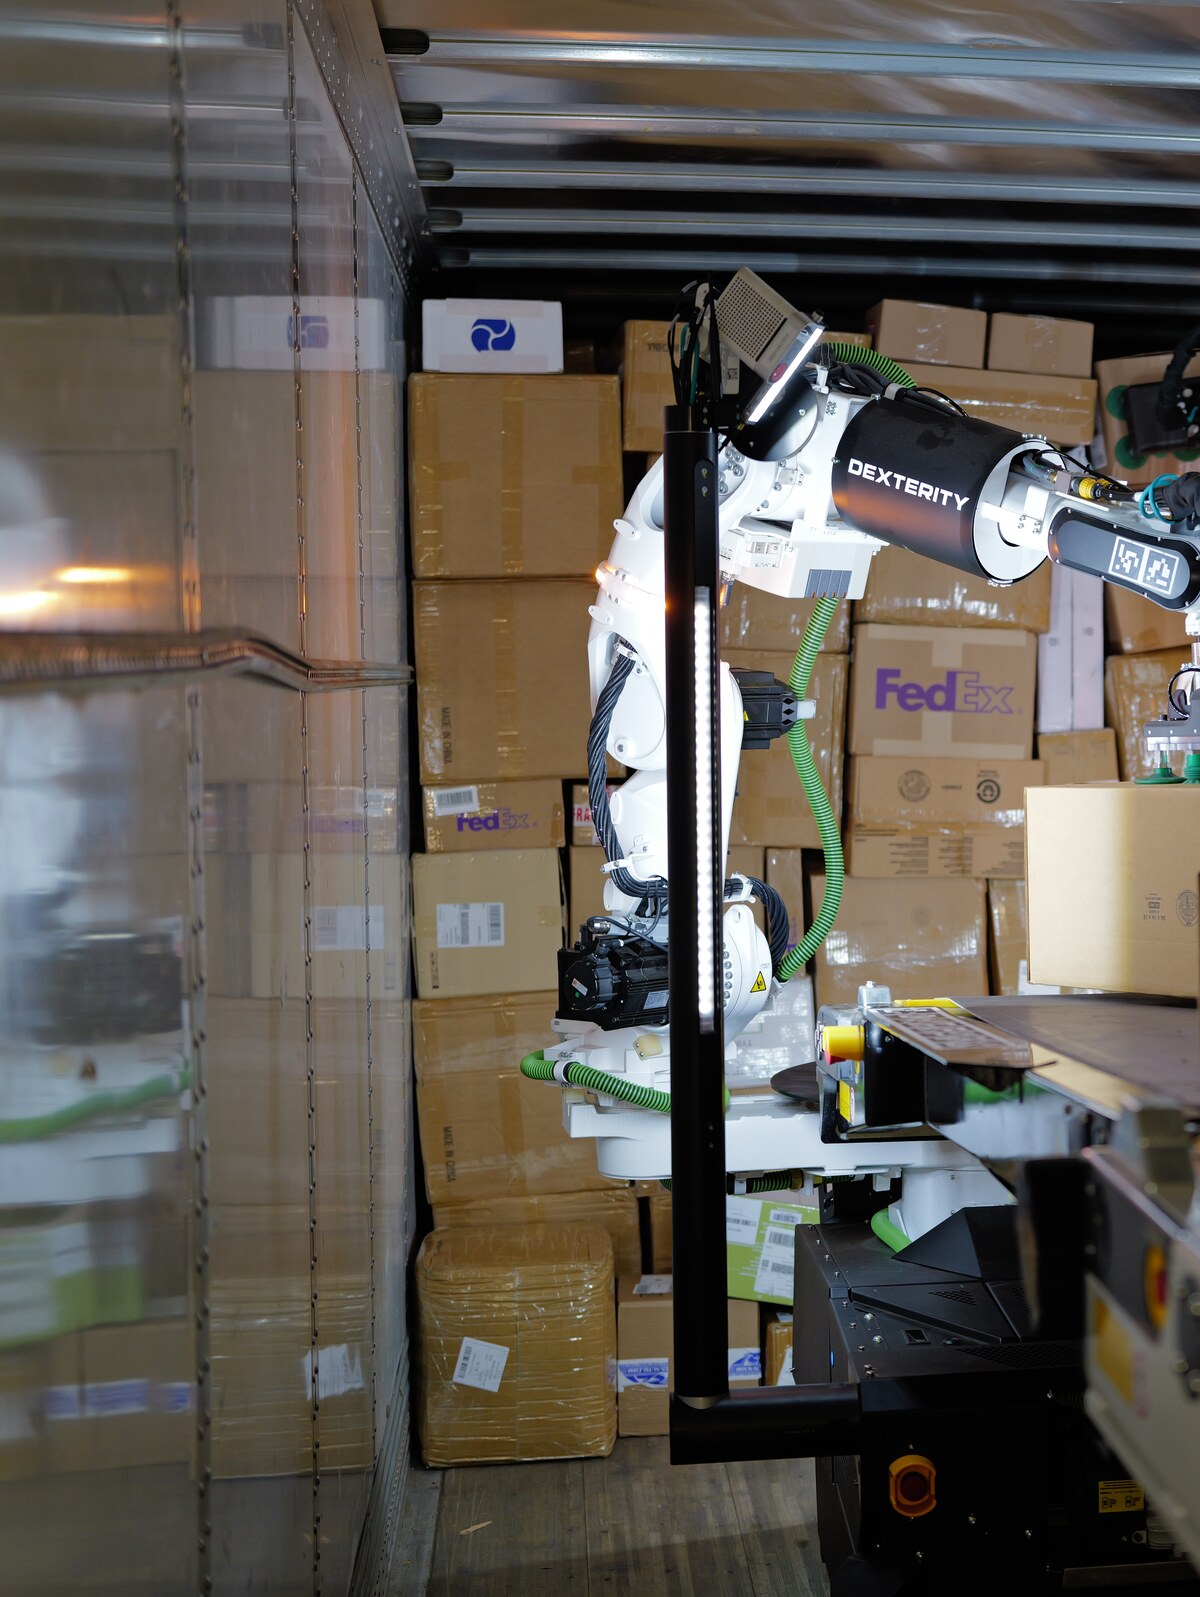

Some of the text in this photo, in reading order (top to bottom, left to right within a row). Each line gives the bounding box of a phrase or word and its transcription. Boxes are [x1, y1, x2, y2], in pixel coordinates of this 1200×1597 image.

[847, 457, 970, 511] DEXTERITY
[875, 668, 1015, 714] FedEx
[441, 706, 453, 764] MADE IN CHINA
[443, 1126, 454, 1148] MADE
